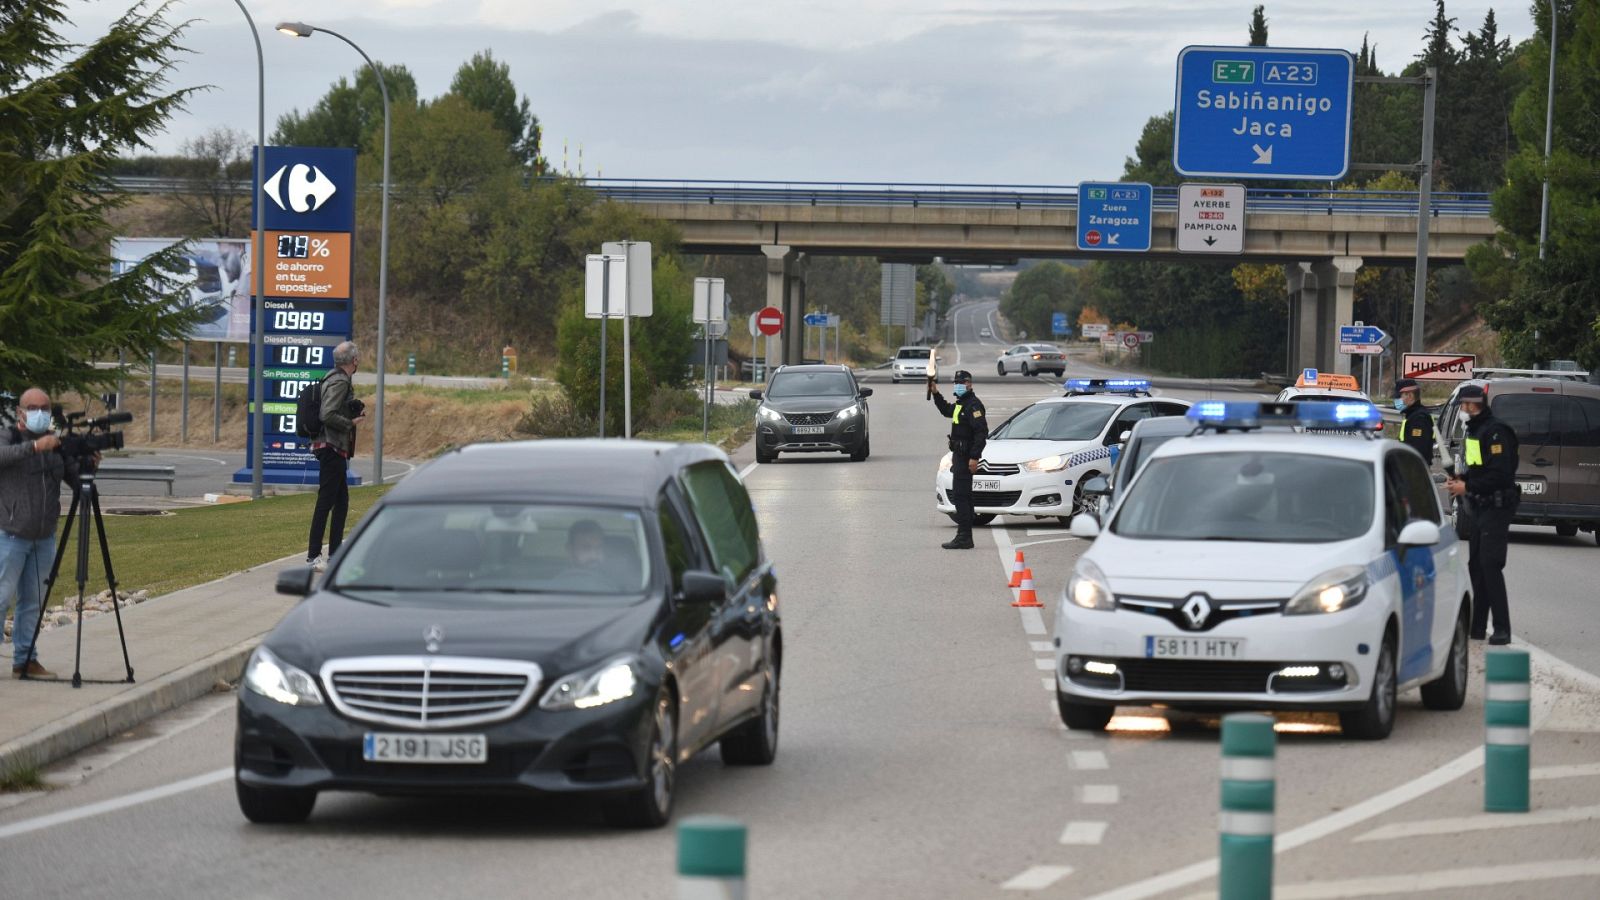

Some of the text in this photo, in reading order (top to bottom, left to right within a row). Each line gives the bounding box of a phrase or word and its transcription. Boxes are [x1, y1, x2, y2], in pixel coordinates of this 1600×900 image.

[1216, 64, 1314, 81] E-7 A-23
[1197, 90, 1332, 116] Sabiñanigo
[1232, 116, 1292, 138] Jaca
[1090, 190, 1137, 199] E-7 A-23
[1102, 204, 1127, 212] Zuera
[1193, 201, 1231, 209] AYERBE
[1089, 215, 1139, 226] Zaragoza
[1184, 223, 1237, 231] PAMPLONA
[276, 262, 324, 271] de ahorro
[290, 273, 306, 282] tus
[287, 337, 313, 345] Design
[1411, 361, 1466, 373] HUESCA
[1306, 371, 1313, 379] L
[984, 481, 999, 489] HNG
[1157, 639, 1239, 656] 5811 HTY
[378, 738, 481, 758] 2191 JSG
